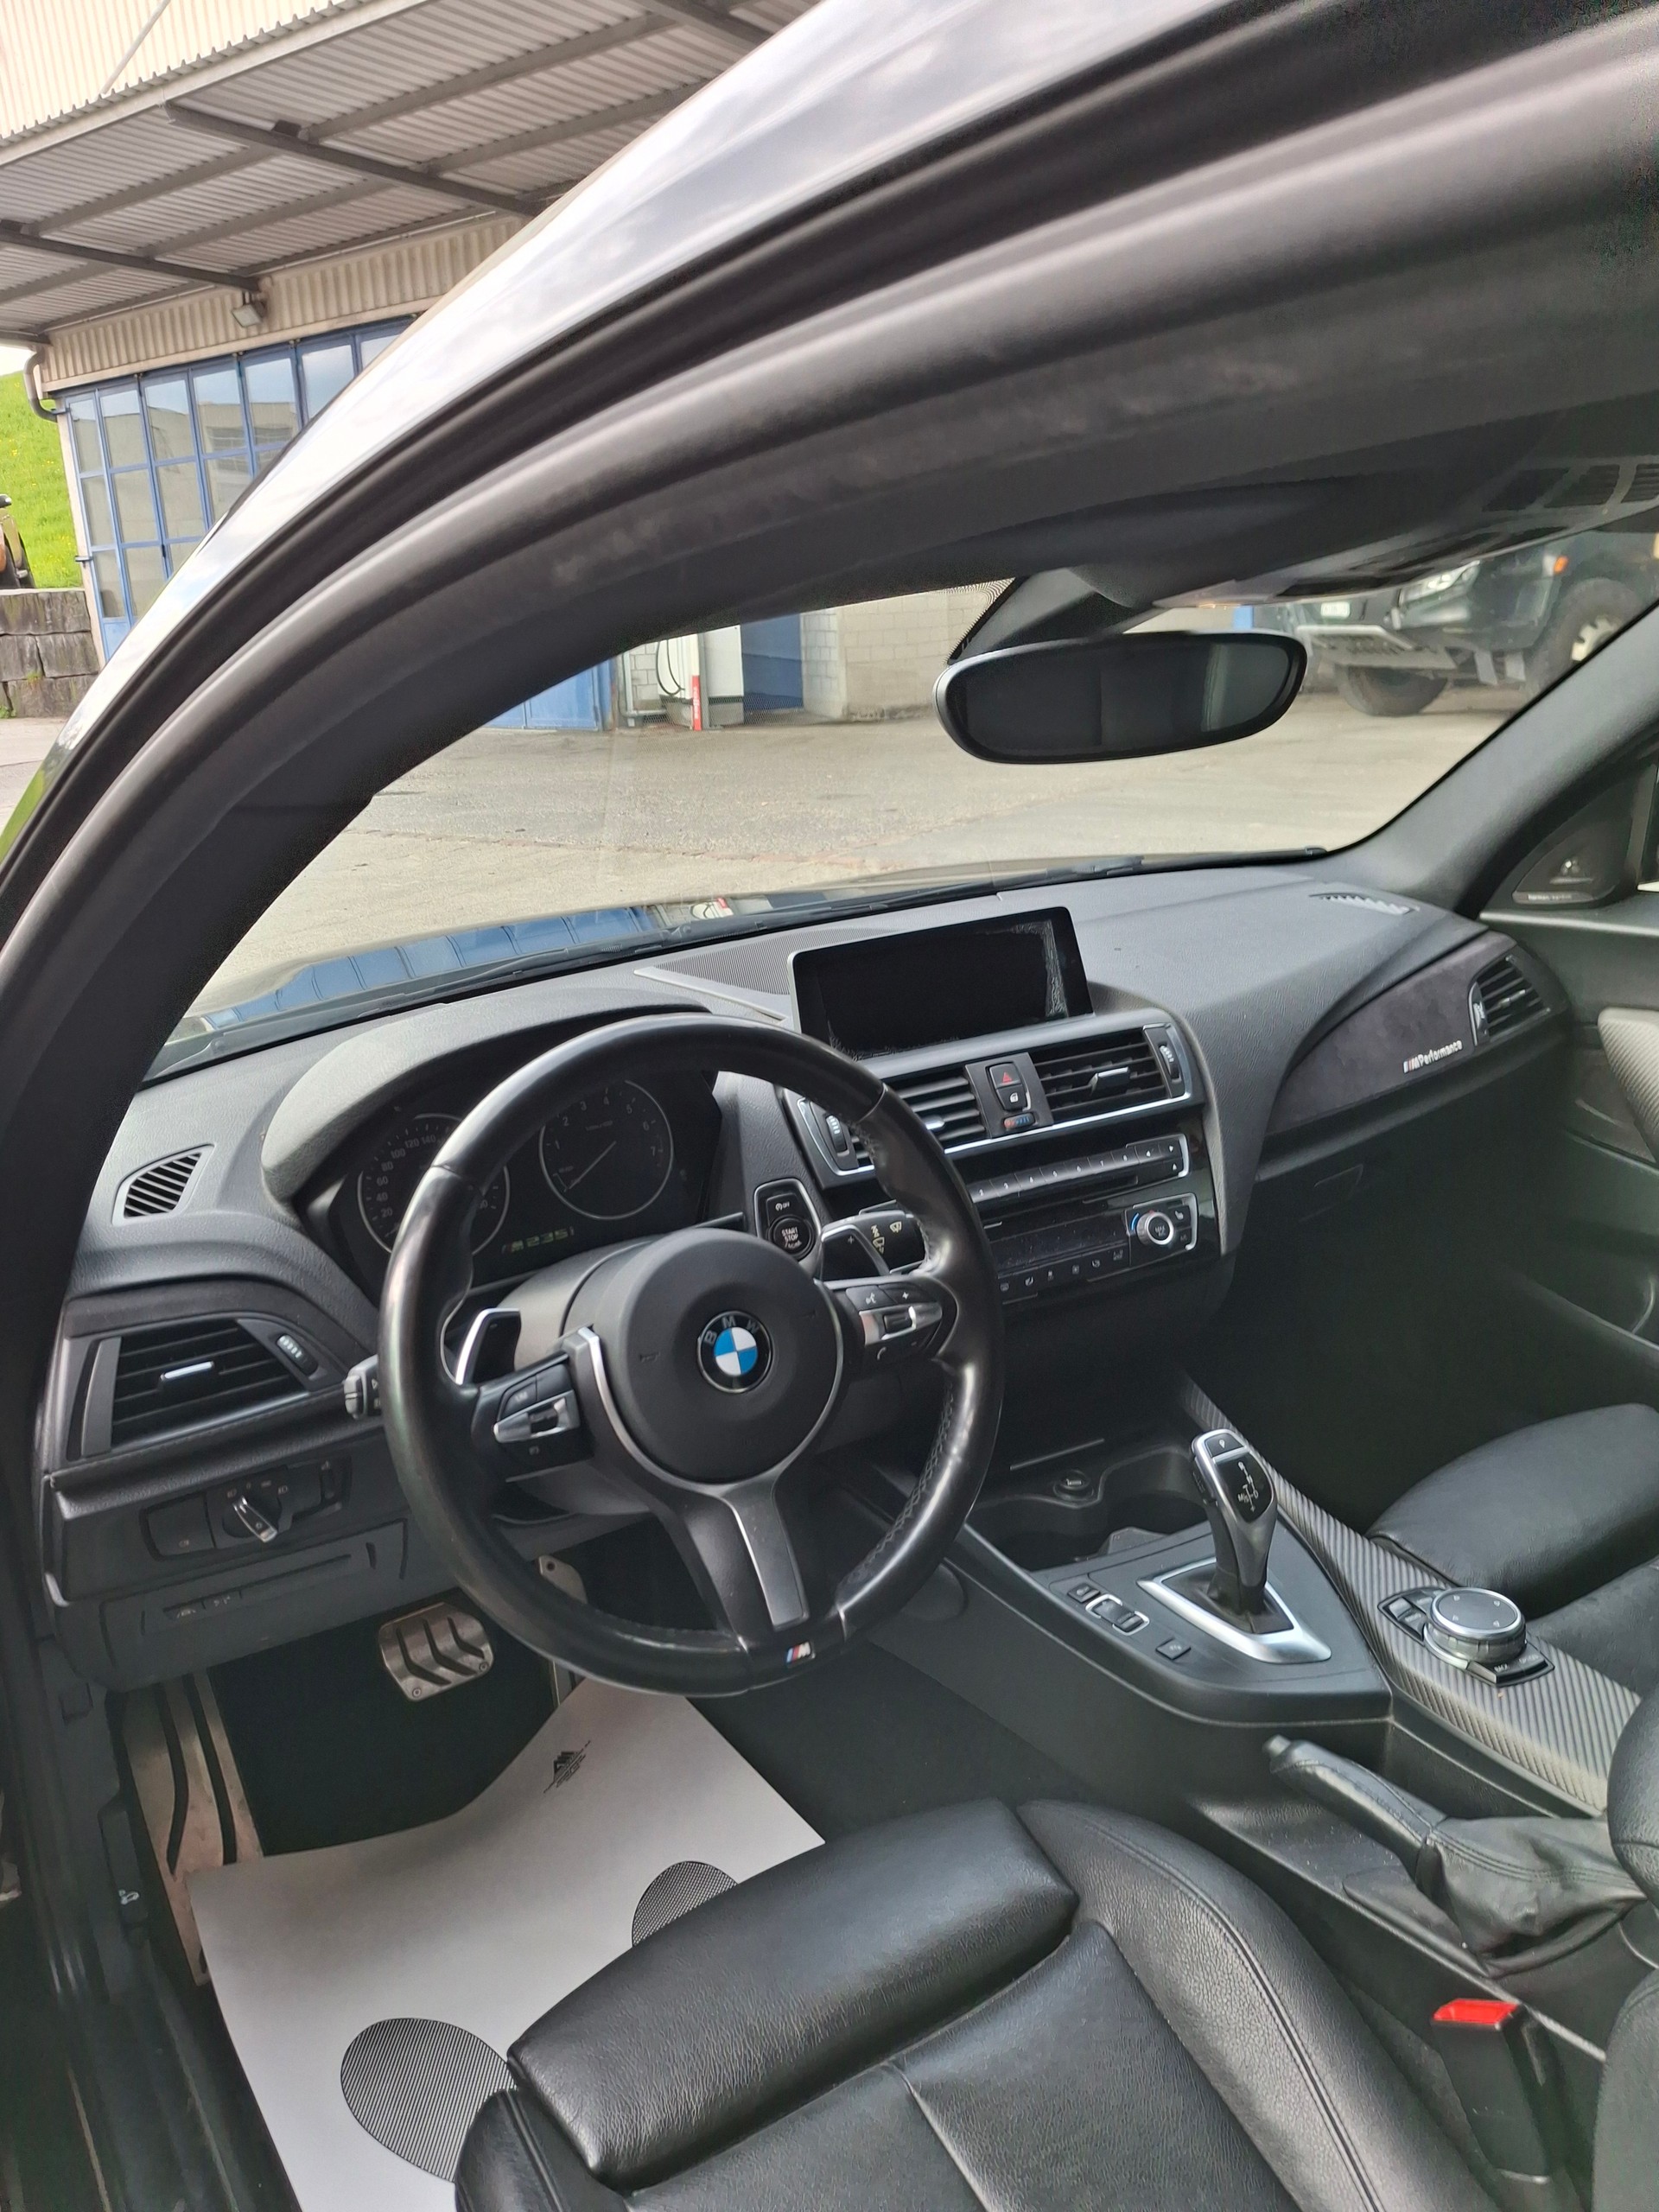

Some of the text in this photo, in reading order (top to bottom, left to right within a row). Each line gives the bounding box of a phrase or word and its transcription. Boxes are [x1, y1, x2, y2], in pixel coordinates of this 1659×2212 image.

[580, 1101, 588, 1111] 3
[626, 1104, 632, 1114] 5
[563, 1116, 569, 1127] 2
[643, 1122, 650, 1131] 6
[404, 1139, 420, 1148] 120
[422, 1135, 436, 1145] 140
[391, 1147, 406, 1160] 100
[651, 1146, 656, 1156] 7
[381, 1161, 394, 1172] 80
[377, 1176, 388, 1186] 60
[376, 1192, 388, 1202] 40
[380, 1207, 393, 1217] 20
[781, 1226, 798, 1236] START
[785, 1234, 799, 1243] STOP
[703, 1315, 760, 1346] BMW
